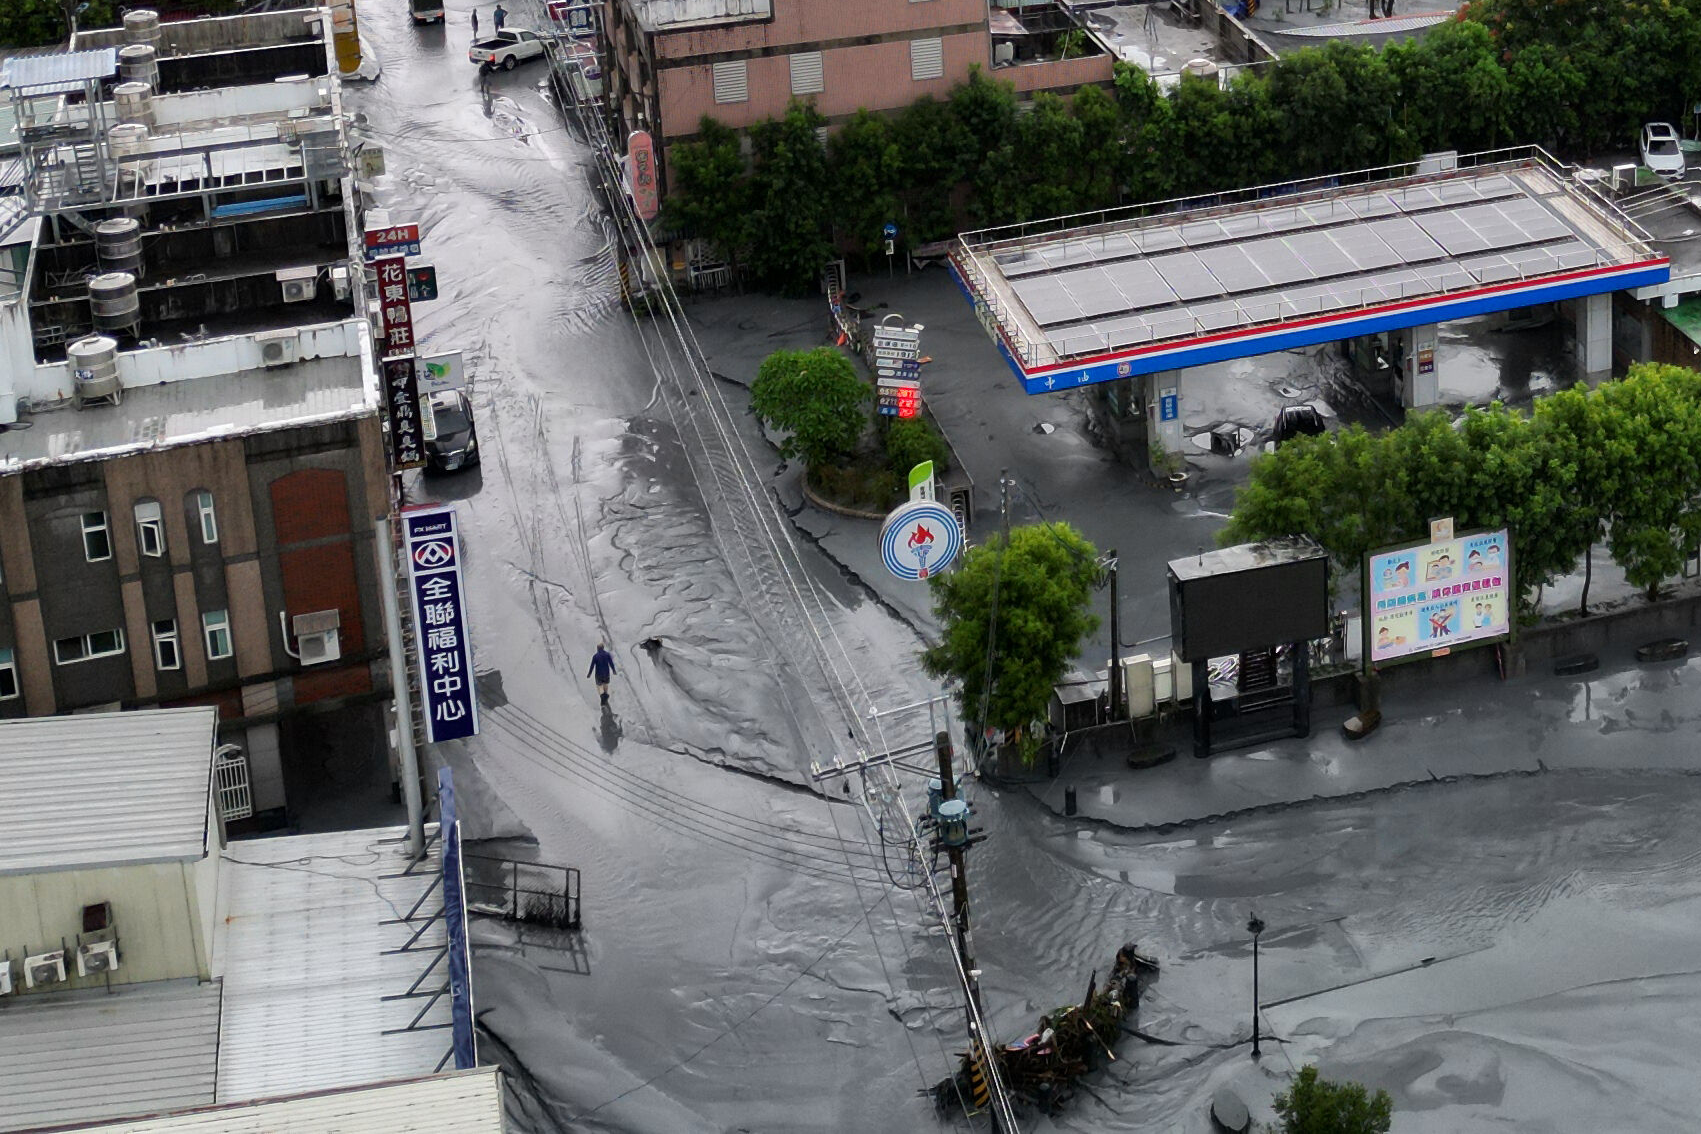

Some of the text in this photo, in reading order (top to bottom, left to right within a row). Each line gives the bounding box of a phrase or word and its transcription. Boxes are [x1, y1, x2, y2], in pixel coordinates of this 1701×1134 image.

[376, 229, 409, 243] 24H
[381, 264, 410, 345] 花東鴨莊
[421, 577, 466, 722] 全聯福利中心
